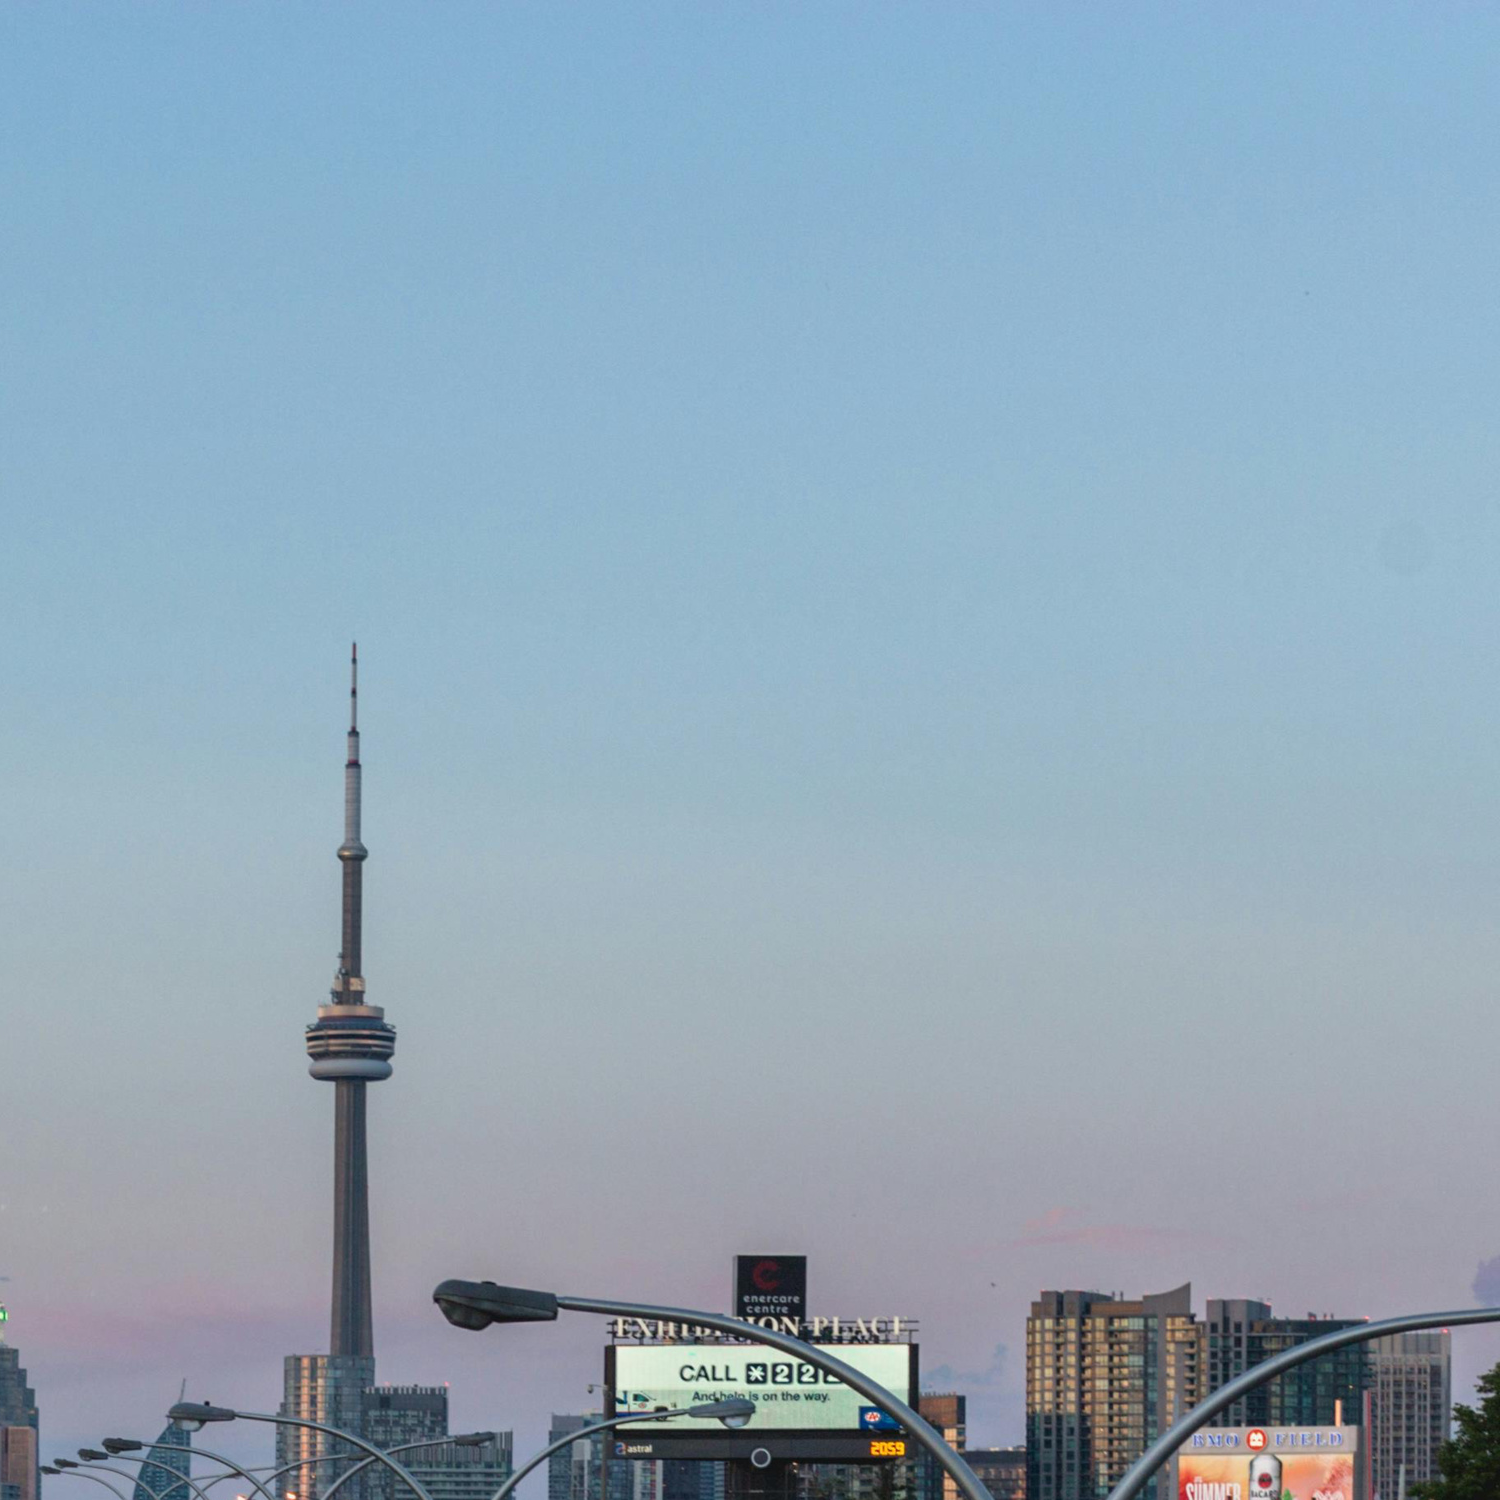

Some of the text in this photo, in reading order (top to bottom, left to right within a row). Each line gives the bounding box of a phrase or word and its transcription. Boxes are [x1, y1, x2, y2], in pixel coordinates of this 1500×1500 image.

[742, 1295, 801, 1304] enercare
[745, 1304, 790, 1314] centre
[811, 1315, 908, 1338] PLACE
[679, 1365, 738, 1382] CALL
[692, 1391, 717, 1402] And
[748, 1391, 759, 1401] is
[762, 1393, 778, 1401] on
[781, 1391, 801, 1401] the
[803, 1393, 831, 1403] way.
[1192, 1432, 1343, 1448] BMO FIELD
[626, 1443, 652, 1453] astral
